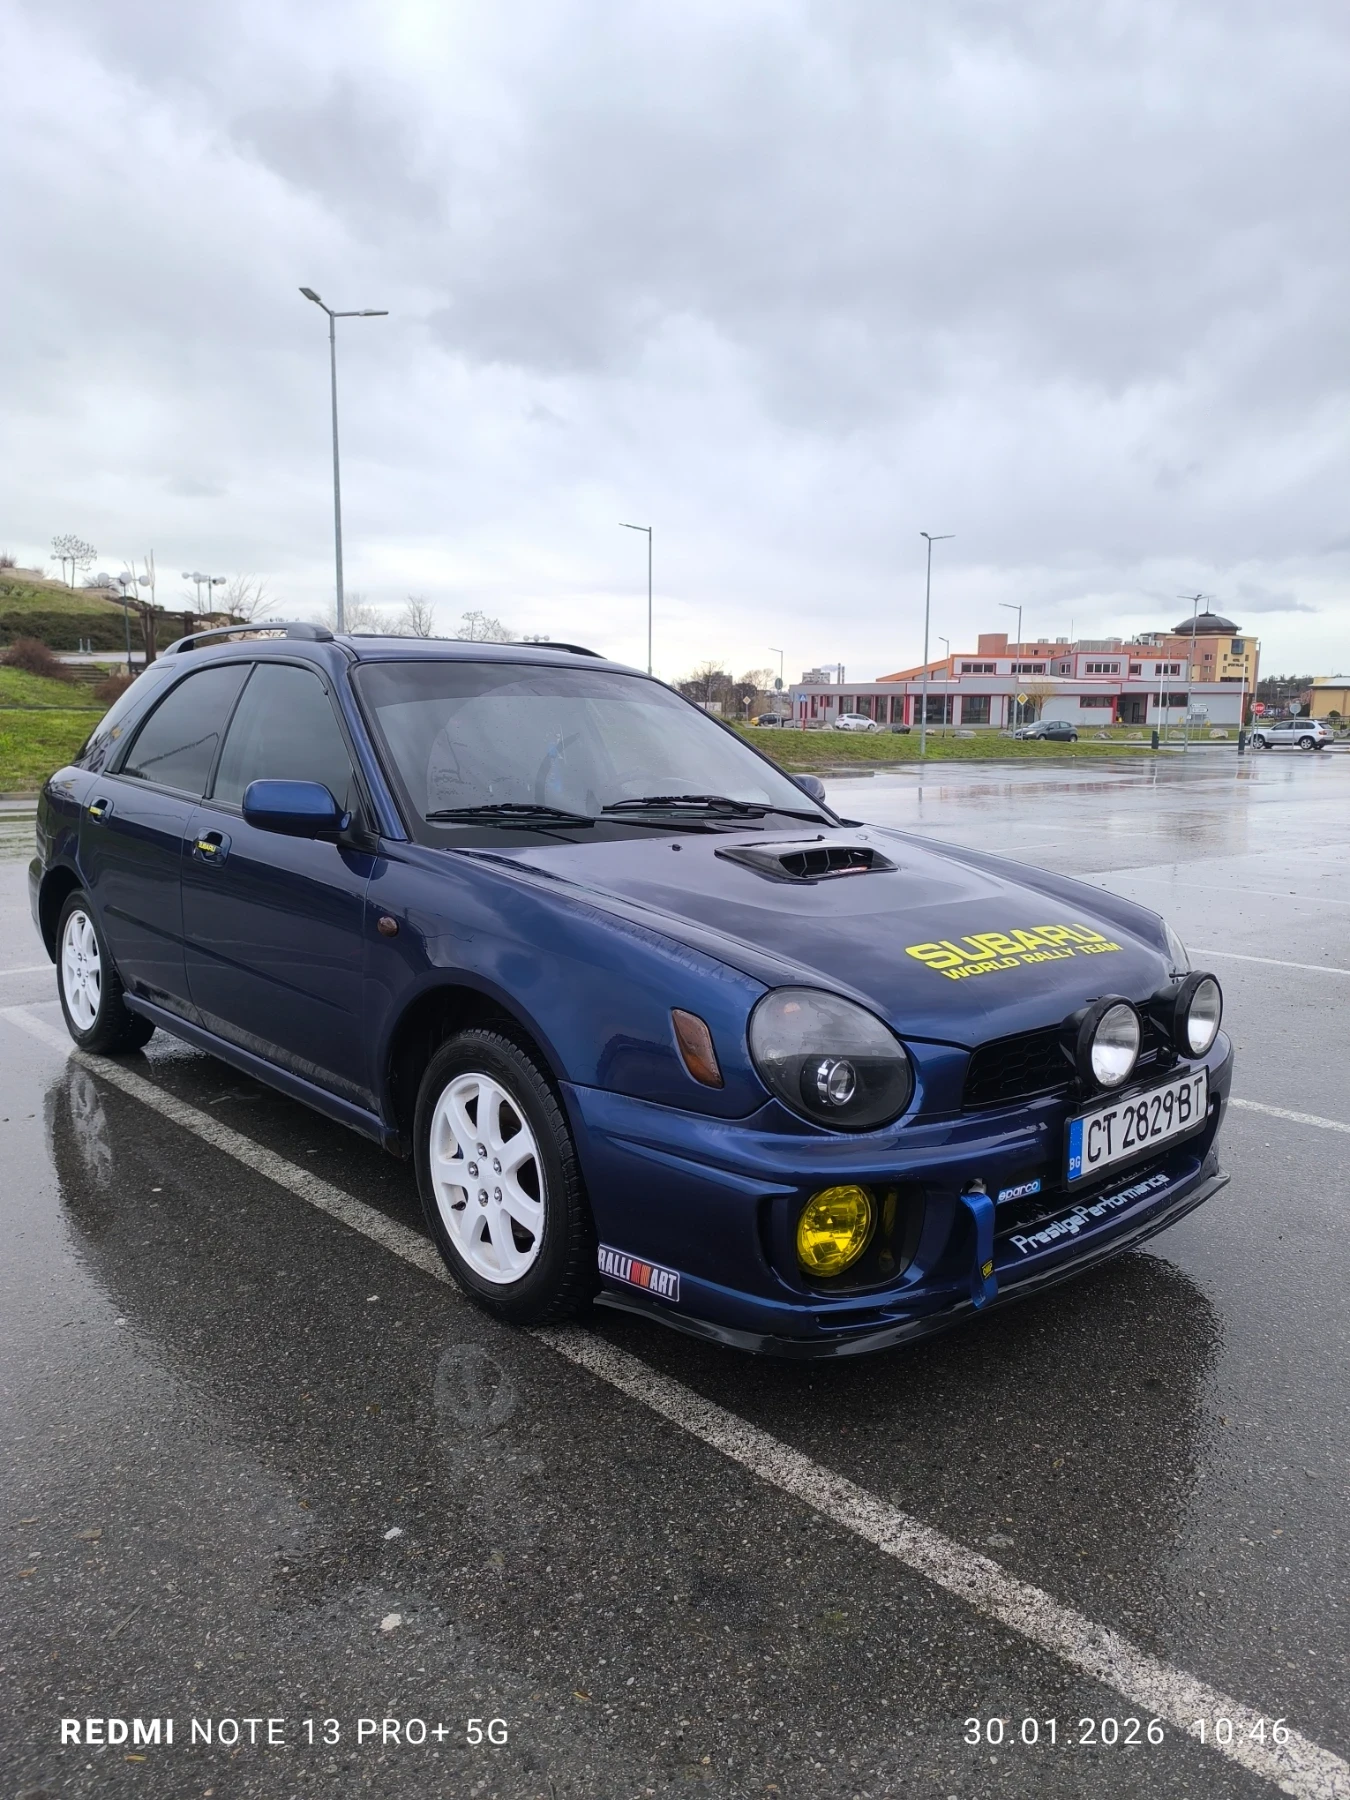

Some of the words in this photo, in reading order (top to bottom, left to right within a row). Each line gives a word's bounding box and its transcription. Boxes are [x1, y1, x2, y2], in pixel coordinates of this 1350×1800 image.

[905, 923, 1107, 969] SUBARU
[940, 956, 1021, 980] WORLD
[1020, 947, 1077, 964] RALLY
[1075, 942, 1124, 954] TEAM
[1087, 1111, 1117, 1163] CT
[1122, 1090, 1174, 1149] 2829
[1178, 1076, 1203, 1124] BT
[1069, 1156, 1081, 1171] BG
[1009, 1173, 1170, 1254] PrestigePerformance
